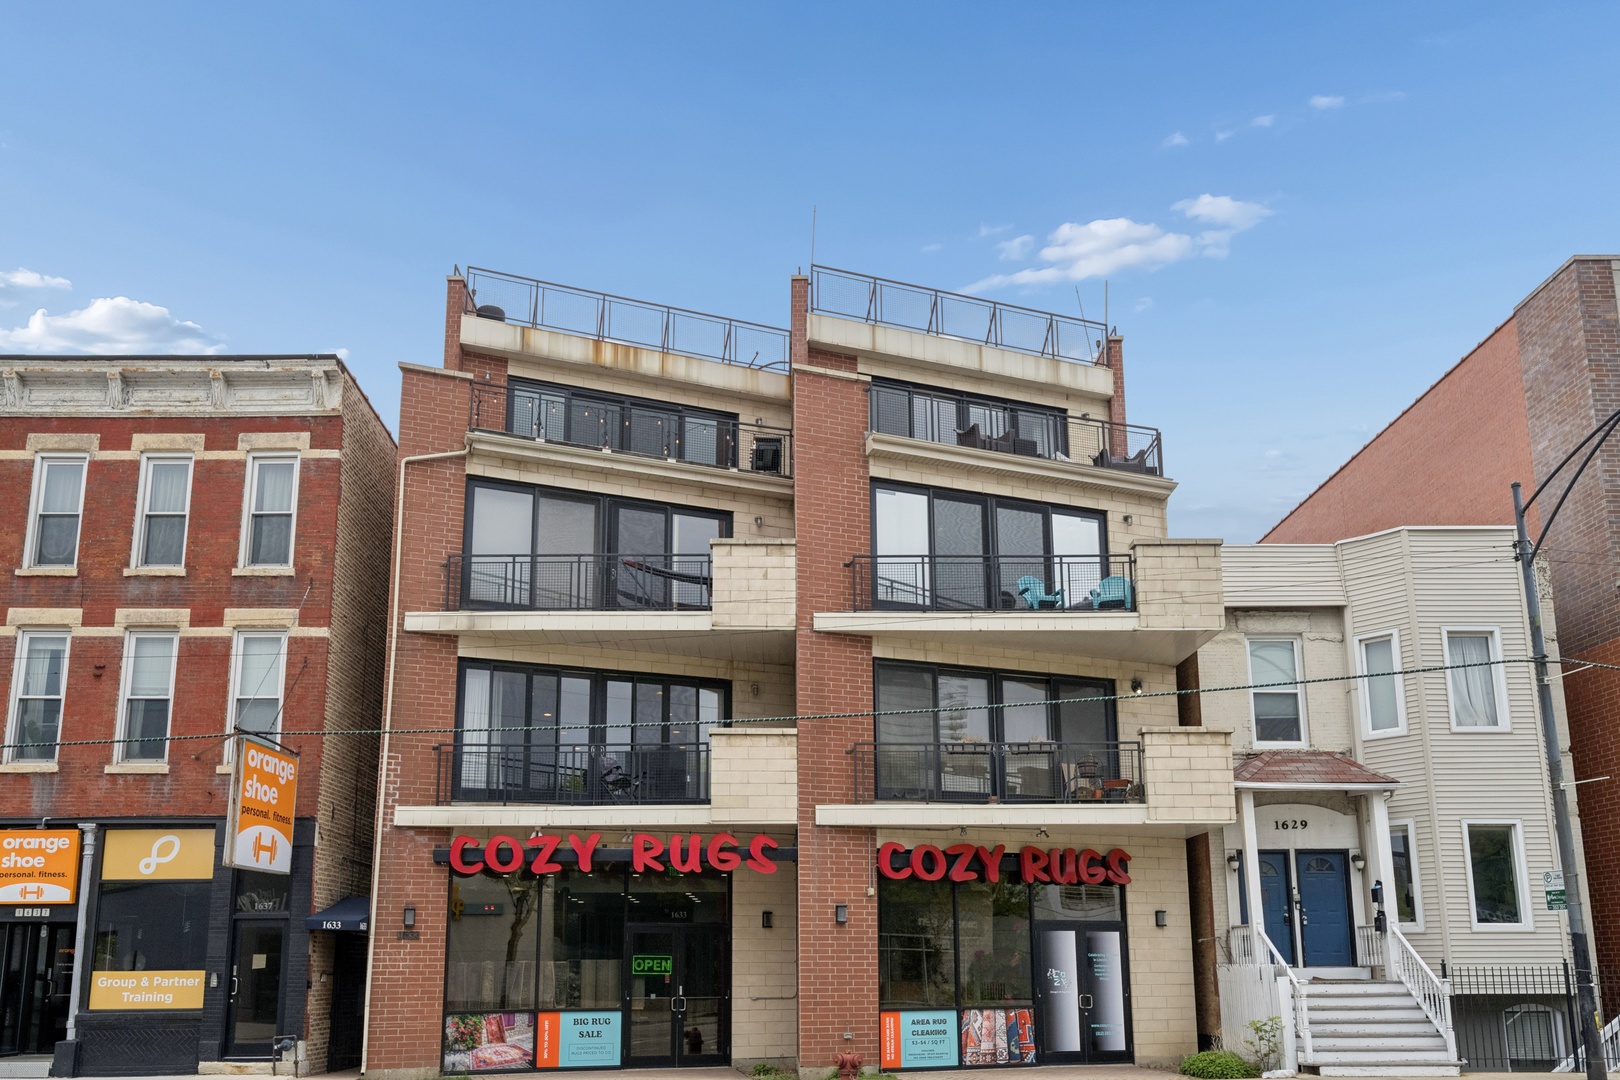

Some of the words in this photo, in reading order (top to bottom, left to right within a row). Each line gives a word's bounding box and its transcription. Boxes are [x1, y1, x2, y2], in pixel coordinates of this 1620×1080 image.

[247, 749, 295, 785] orange
[244, 773, 278, 805] shoe
[241, 805, 270, 820] personal.
[272, 811, 292, 825] fitness.
[1274, 819, 1308, 830] 1629
[2, 837, 70, 853] orange
[1, 852, 45, 868] shoe
[450, 833, 601, 875] COZY
[632, 832, 779, 874] RUGS
[878, 841, 1006, 884] COZY
[1020, 845, 1132, 885] RUGS
[254, 902, 273, 910] 1637
[671, 911, 687, 919] 1633
[322, 921, 342, 929] 1633
[634, 959, 672, 971] OPEN
[97, 977, 137, 989] Group
[140, 977, 149, 987] &
[153, 976, 201, 986] Partner
[122, 992, 173, 1003] Training
[573, 1018, 589, 1026] BIG
[591, 1017, 611, 1025] RUG
